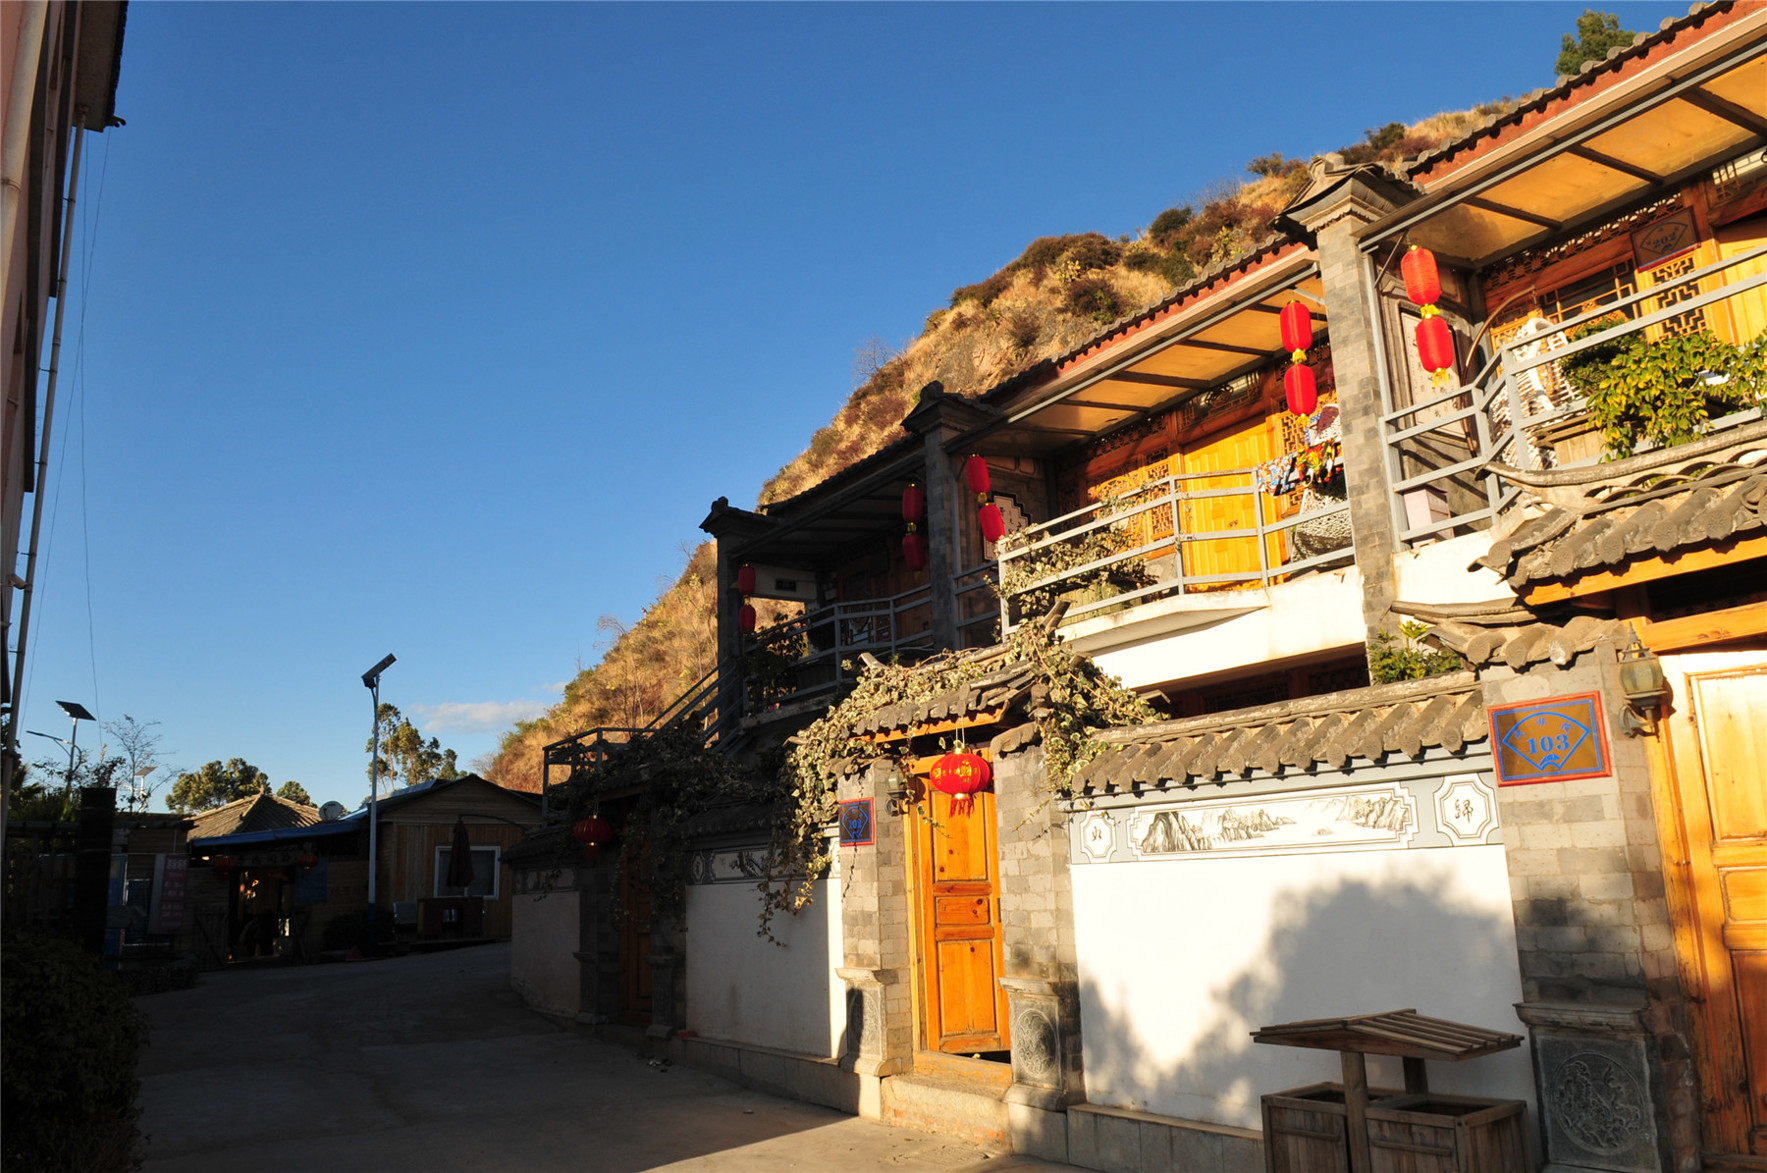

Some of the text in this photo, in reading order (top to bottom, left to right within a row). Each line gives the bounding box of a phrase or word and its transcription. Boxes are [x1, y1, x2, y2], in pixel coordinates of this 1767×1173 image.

[1654, 231, 1677, 248] 202
[1526, 734, 1570, 754] 103
[848, 818, 862, 830] 102
